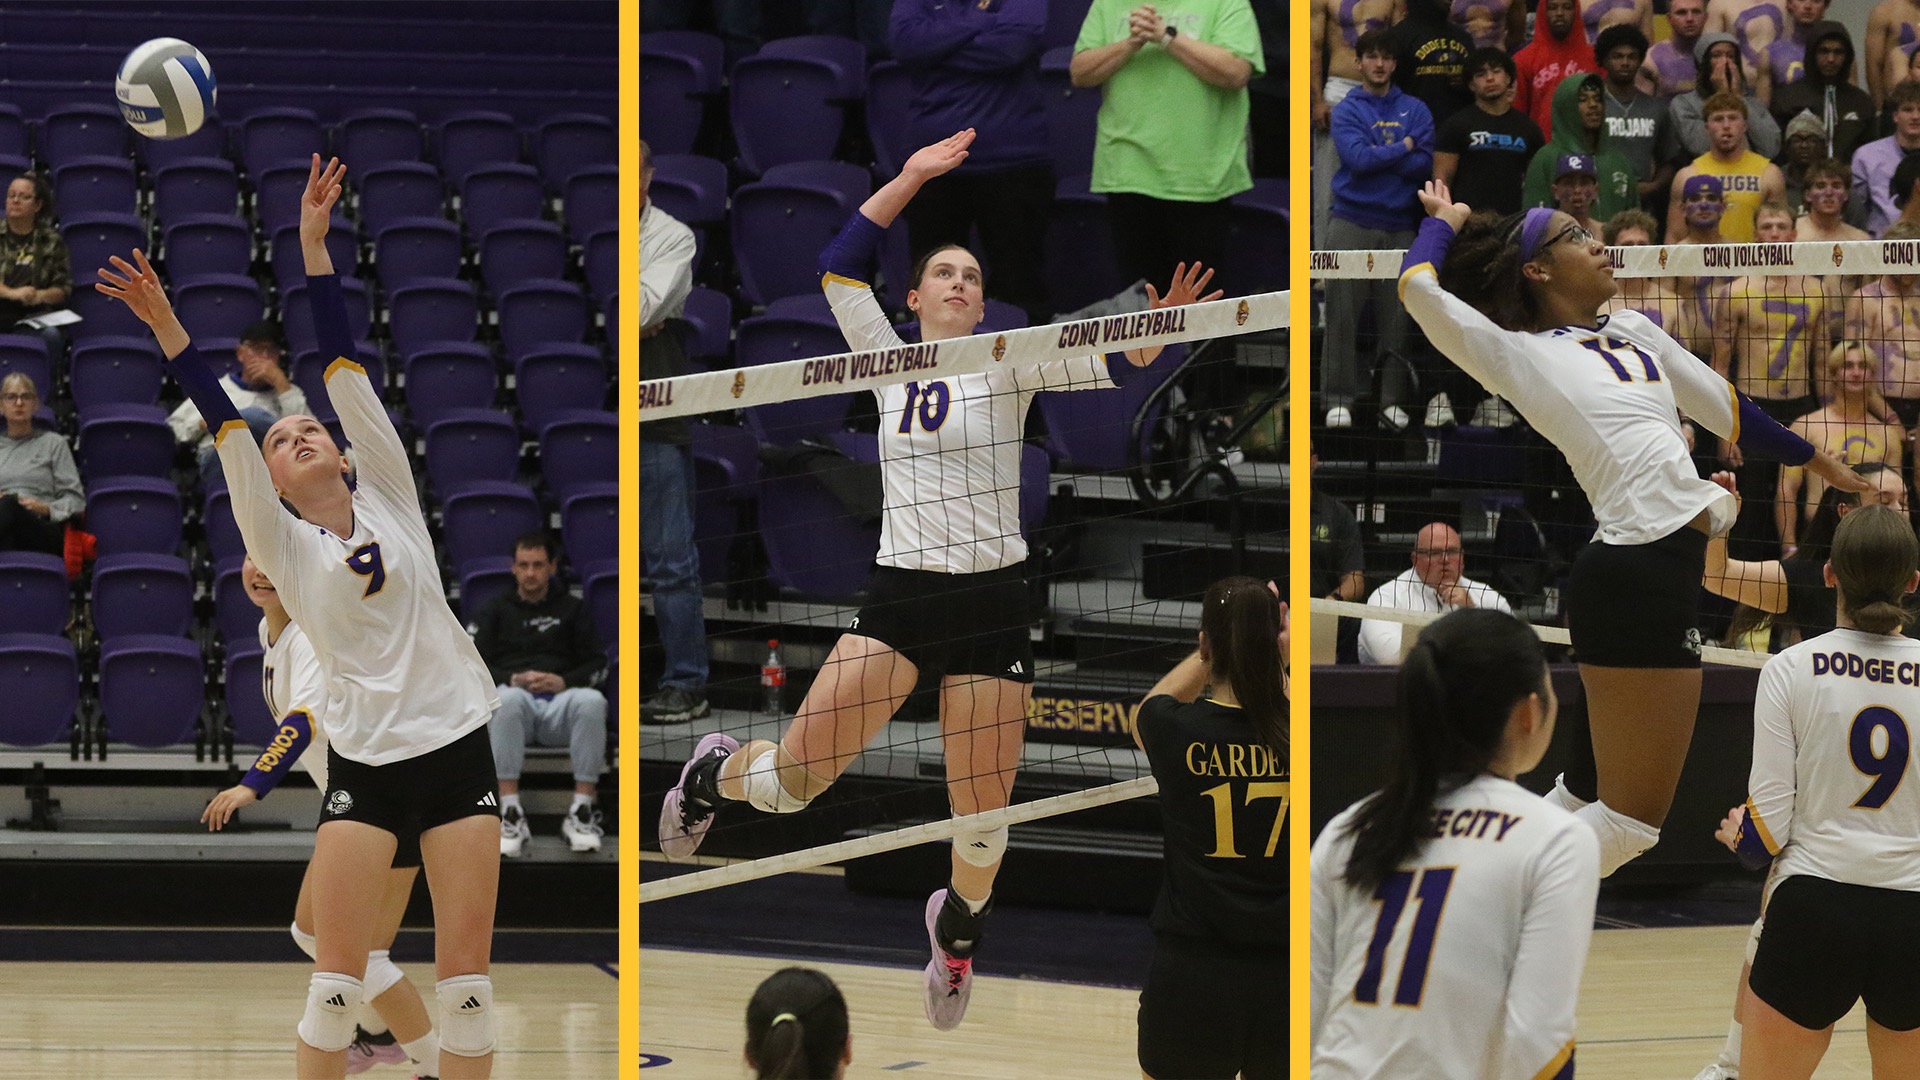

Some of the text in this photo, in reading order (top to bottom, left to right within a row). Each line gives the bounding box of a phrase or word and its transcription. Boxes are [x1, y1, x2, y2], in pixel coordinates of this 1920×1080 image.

[1605, 117, 1656, 137] TROJANS
[1703, 244, 1795, 269] CONQ VOLLEYBALL
[1883, 242, 1913, 266] CONQ
[1058, 308, 1186, 348] CONQ VOLLEYBALL
[1762, 300, 1810, 379] 7
[802, 344, 939, 386] CONQ VOLLEYBALL
[1577, 335, 1662, 384] 17
[639, 381, 673, 408] BALL
[897, 380, 950, 435] 10
[344, 540, 389, 600] 9
[1812, 652, 1895, 685] DODGE
[255, 725, 299, 773] CONQS
[1185, 741, 1290, 777] GARDE
[1847, 703, 1912, 811] 9
[1200, 781, 1290, 858] 17
[1450, 808, 1524, 843] CITY
[1352, 864, 1459, 1010] 11
